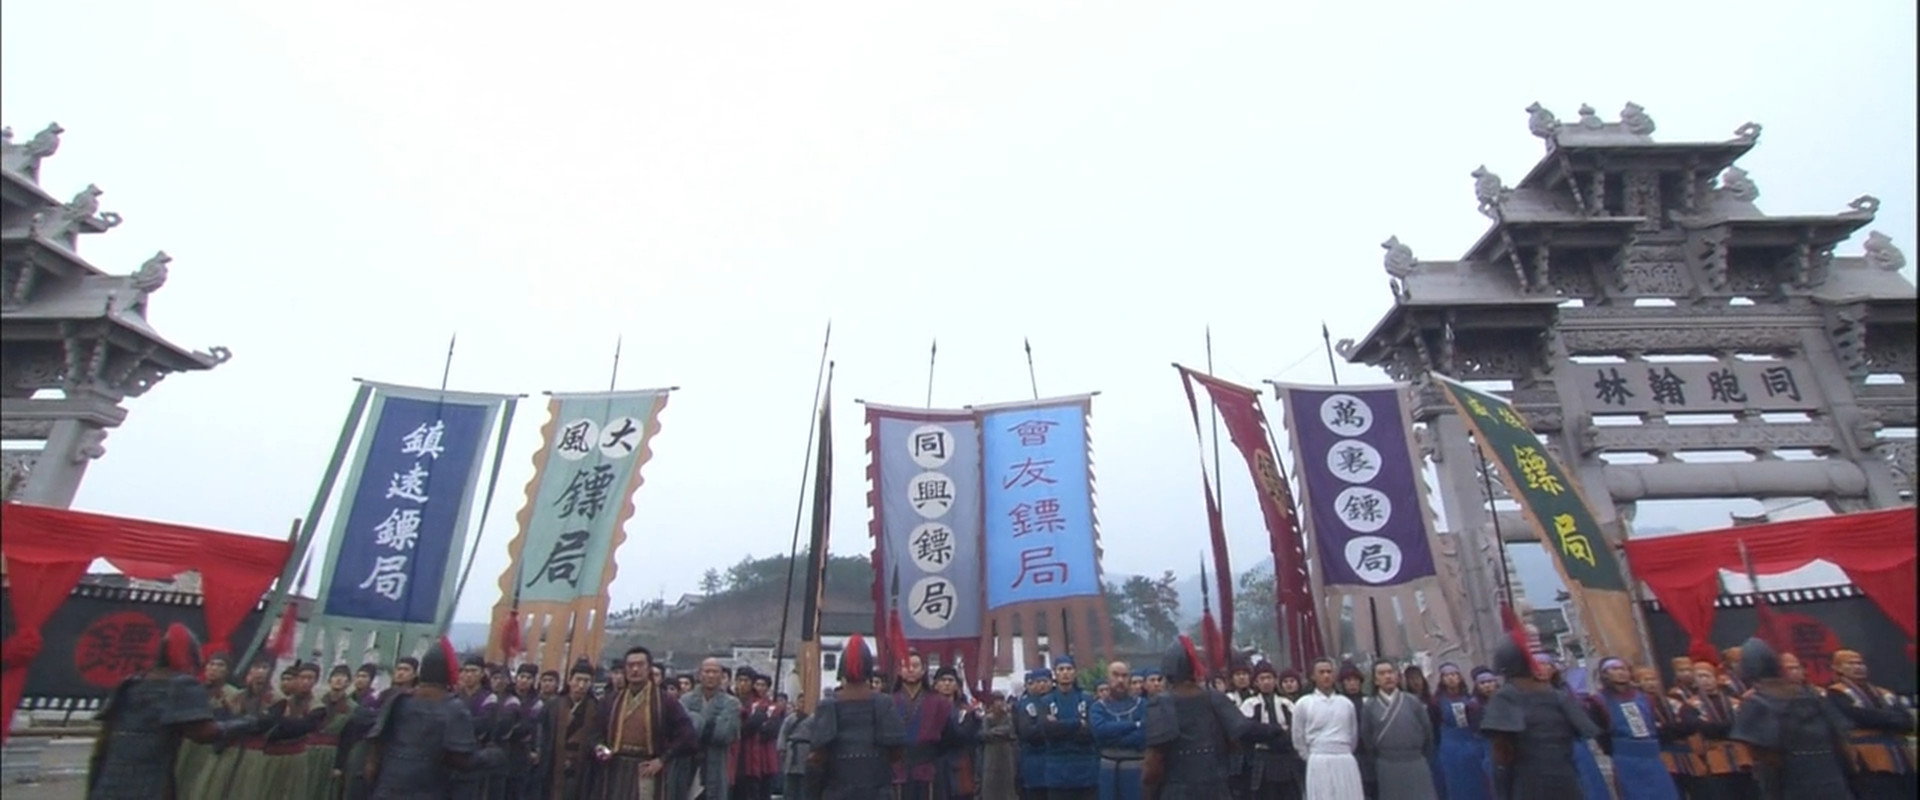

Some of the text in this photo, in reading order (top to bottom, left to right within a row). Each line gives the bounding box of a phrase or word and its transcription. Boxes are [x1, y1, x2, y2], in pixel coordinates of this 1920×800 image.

[359, 419, 446, 601] 鎮遠鏢局
[912, 431, 953, 620] 同興鏢局
[1003, 419, 1068, 590] 會友鏢局
